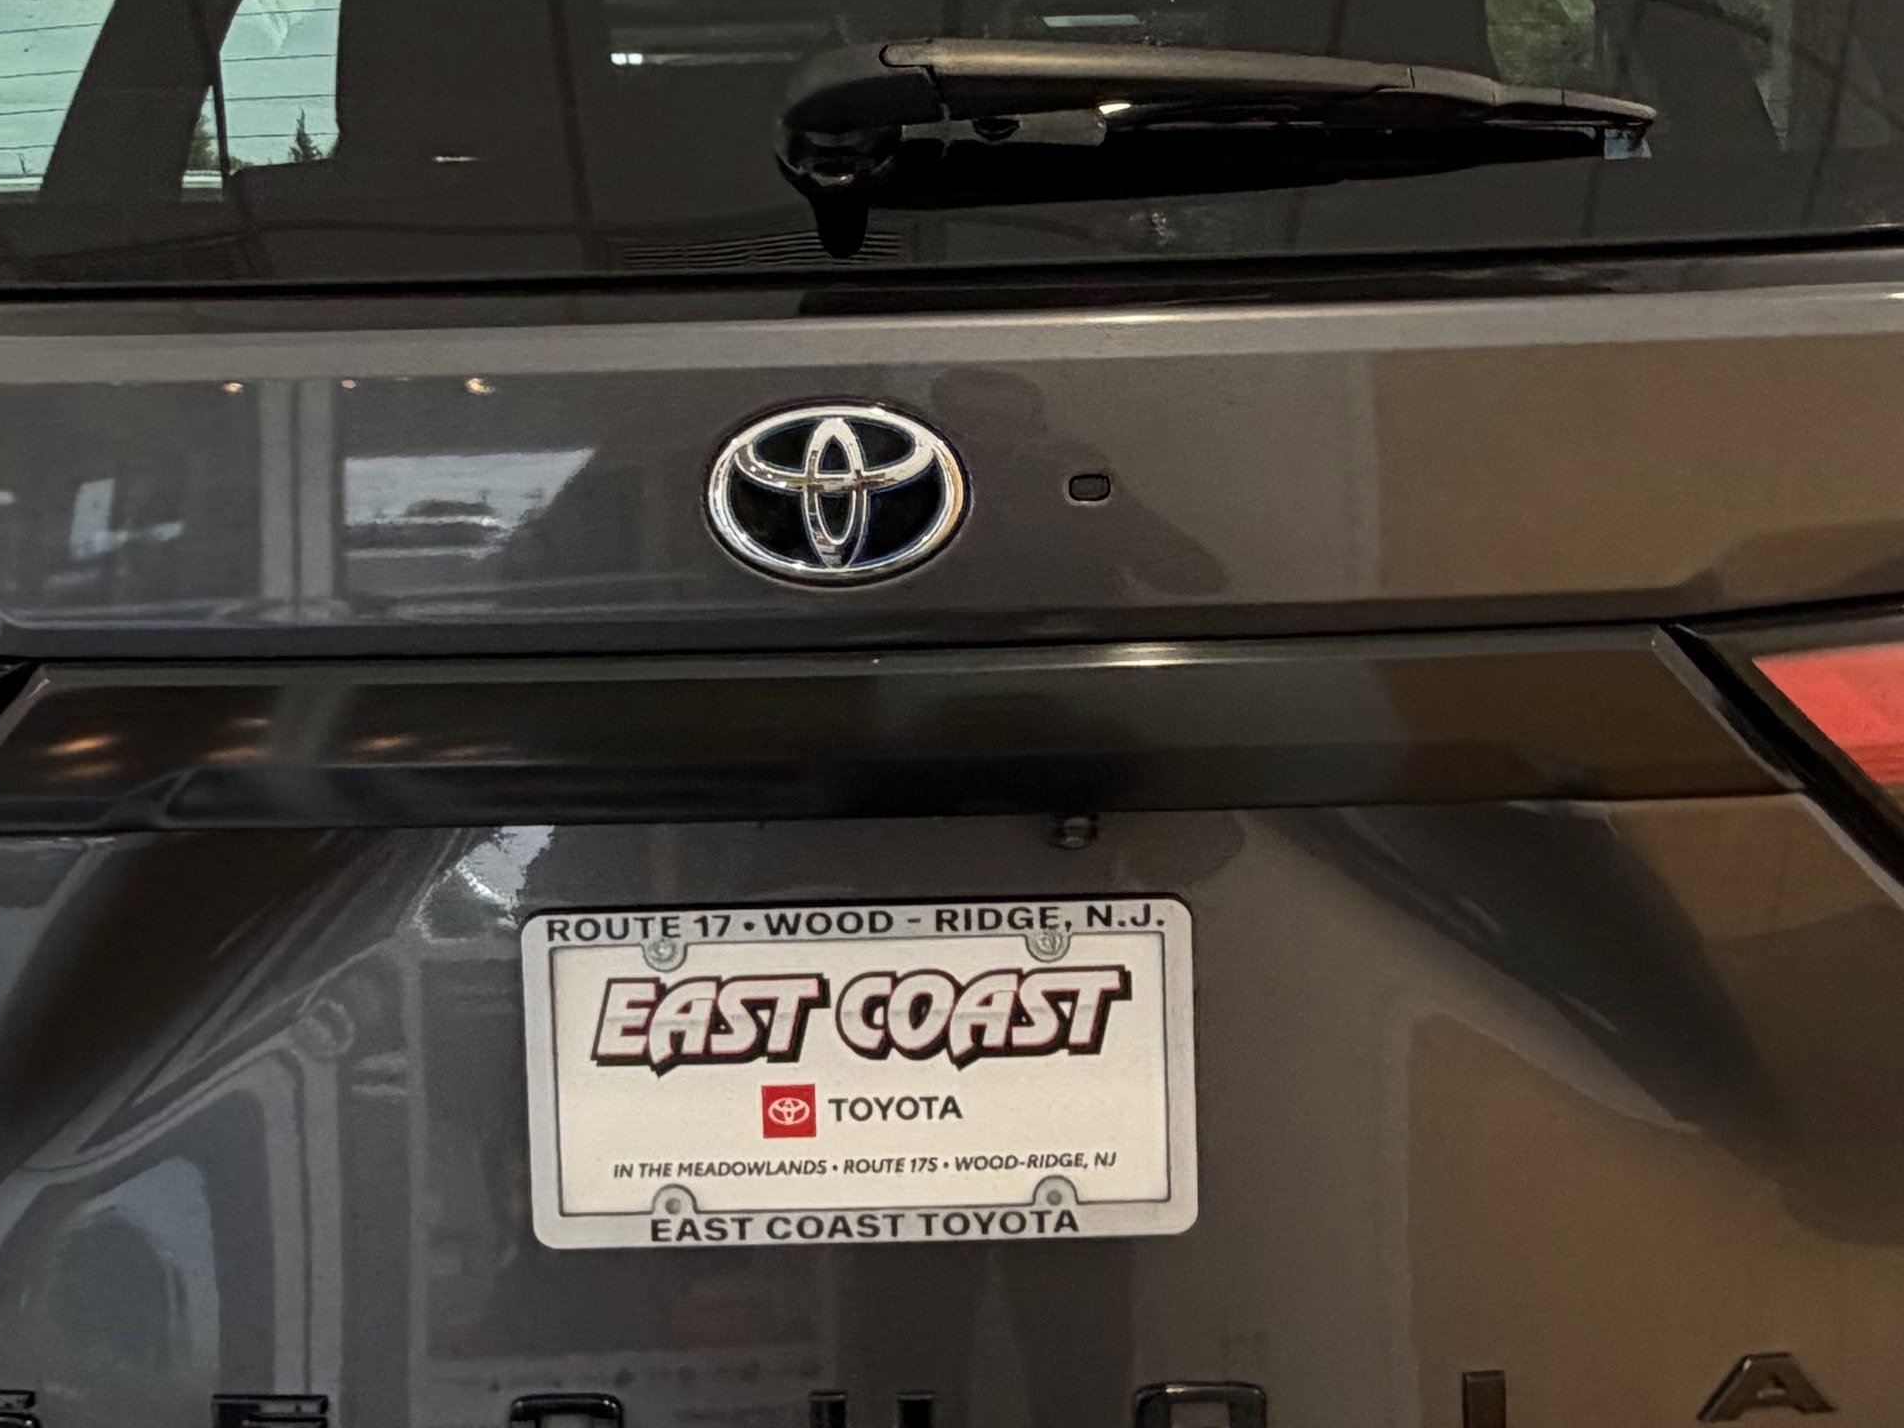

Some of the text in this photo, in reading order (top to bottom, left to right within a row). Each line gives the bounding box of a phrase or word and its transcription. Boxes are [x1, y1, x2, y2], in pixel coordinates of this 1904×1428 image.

[547, 916, 682, 943] ROUTE
[693, 913, 732, 939] 17
[764, 909, 895, 938] WOOD
[1086, 902, 1167, 931] N.J.
[591, 965, 1133, 1079] EAST COAST
[829, 1095, 964, 1123] TOYOTA
[613, 1162, 635, 1179] IN
[638, 1161, 675, 1178] THE
[677, 1159, 828, 1178] MEADOWLANDS
[842, 1156, 907, 1175] ROUTE
[955, 1150, 1090, 1172] WOOD-RIDGE,
[1093, 1151, 1117, 1169] NJ
[650, 1208, 1079, 1243] EAST COAST TOYOTA
